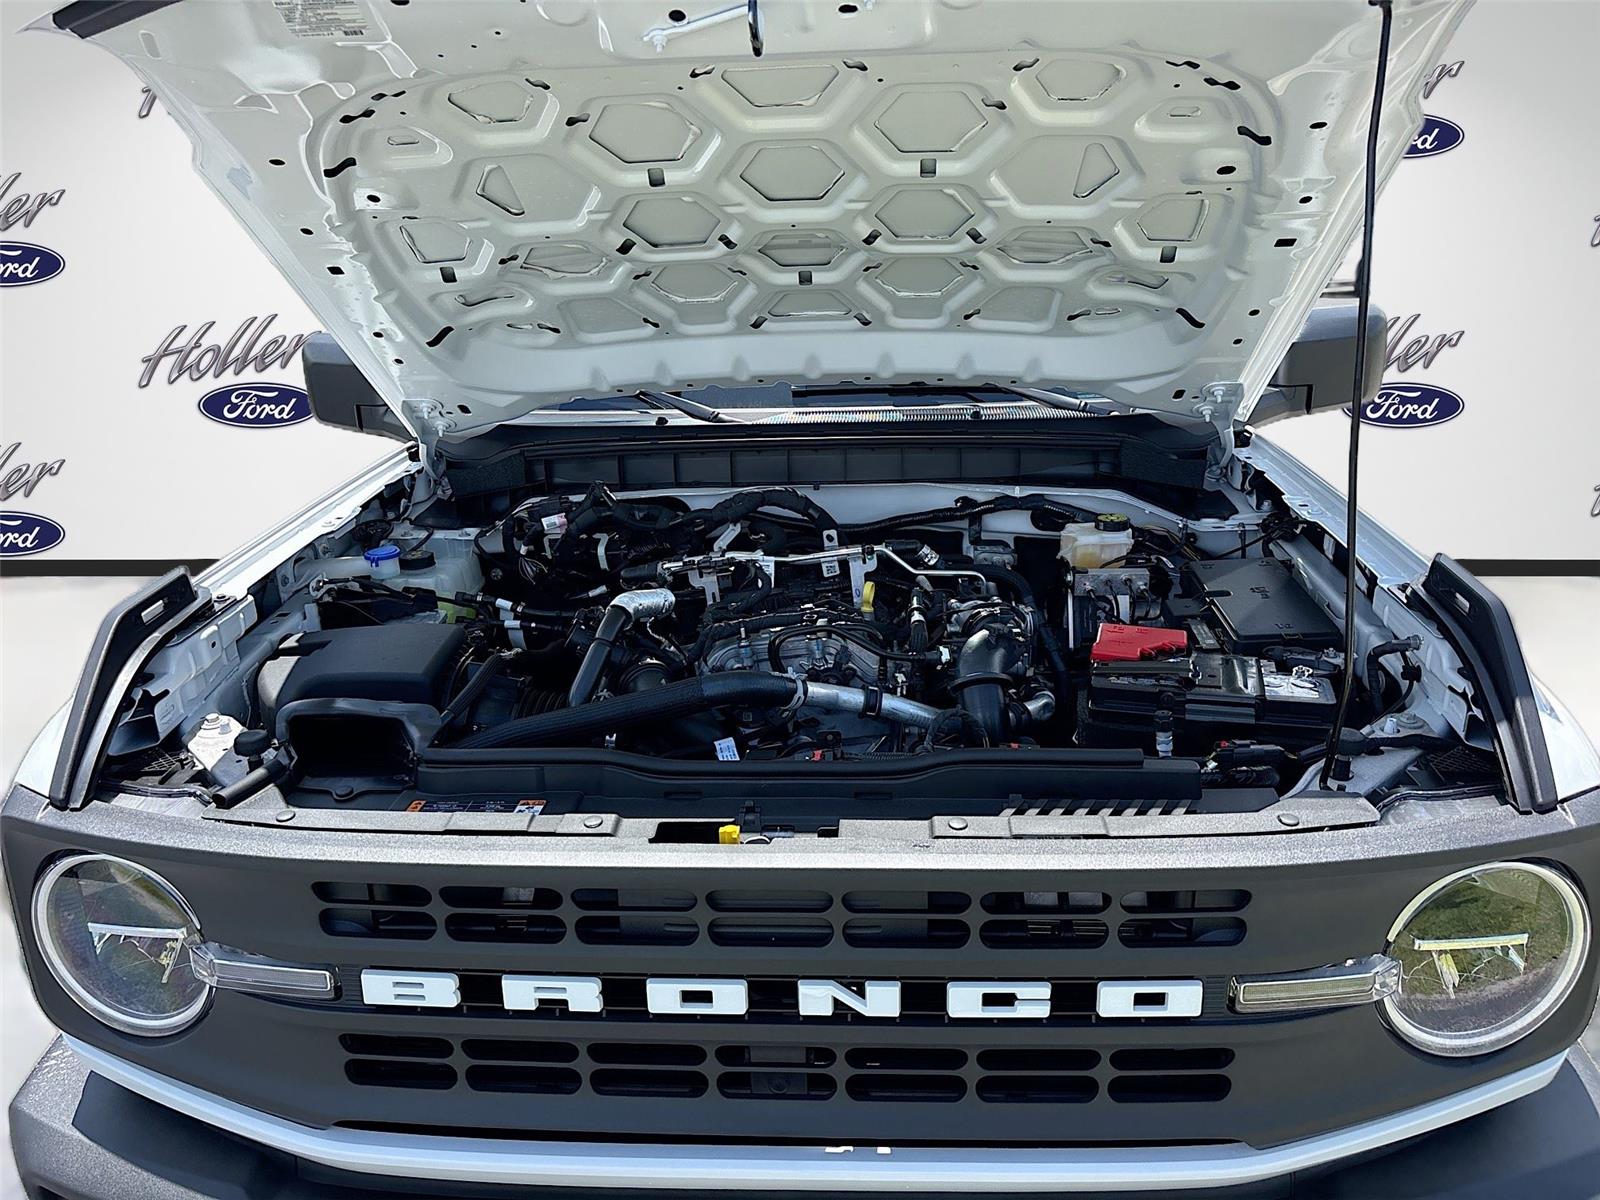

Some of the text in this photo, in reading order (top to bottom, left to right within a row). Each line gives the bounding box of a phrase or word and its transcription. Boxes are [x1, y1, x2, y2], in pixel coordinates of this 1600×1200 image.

[138, 313, 322, 389] Holler
[223, 389, 297, 419] Ford
[1366, 389, 1440, 419] Ford
[361, 968, 1203, 1018] BRONCO
